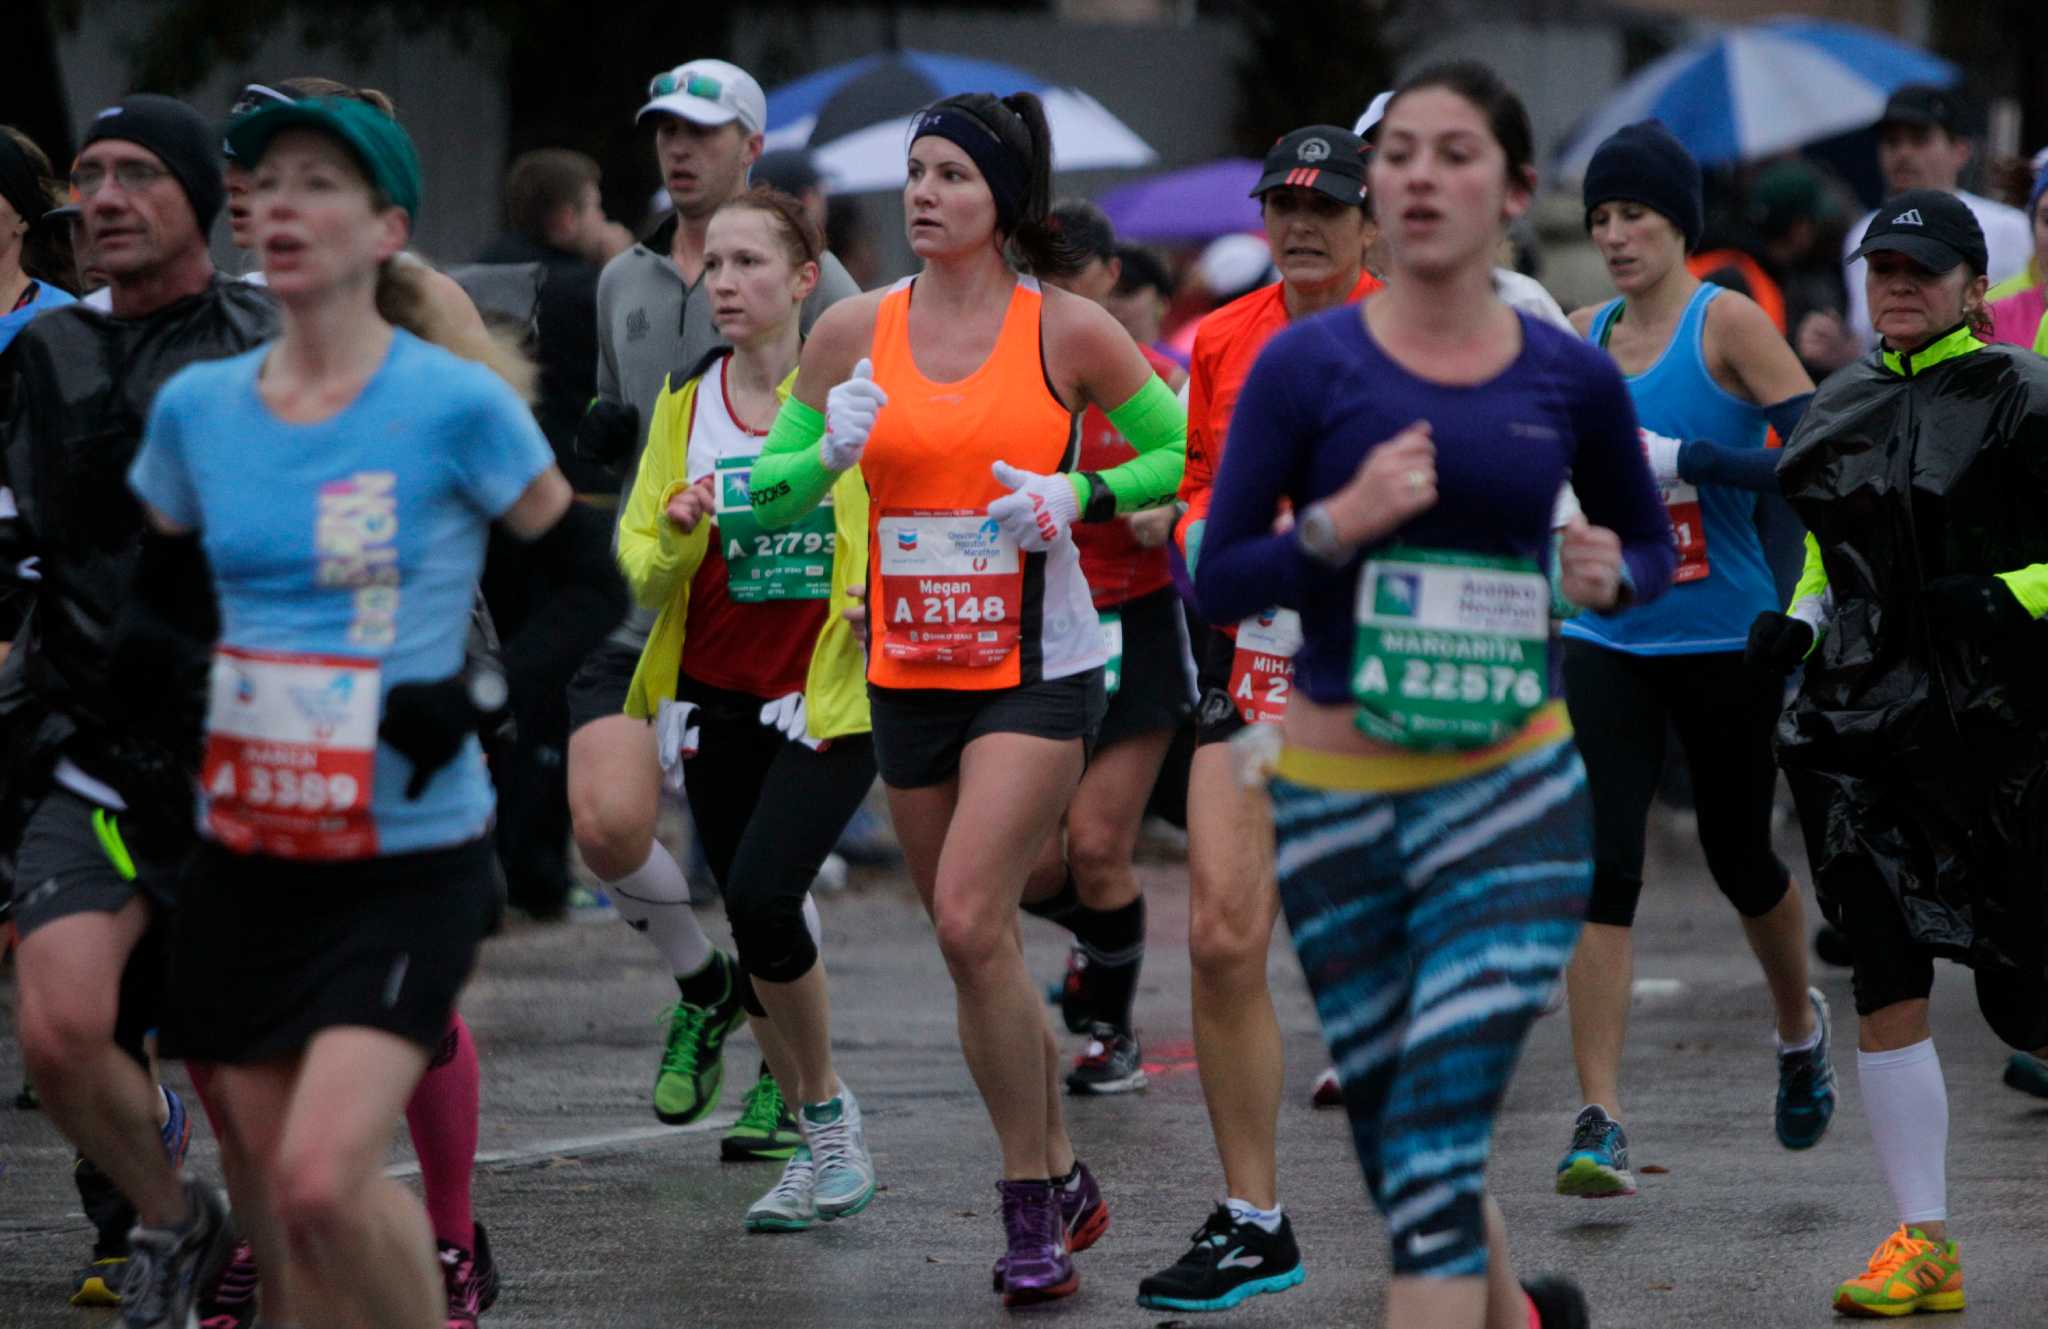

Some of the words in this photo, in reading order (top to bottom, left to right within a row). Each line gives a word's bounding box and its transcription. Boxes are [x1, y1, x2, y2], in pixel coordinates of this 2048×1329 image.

[728, 538, 747, 560] A
[754, 532, 836, 556] 27793
[919, 579, 971, 596] Megan
[894, 597, 913, 623] A
[923, 596, 1006, 624] 2148
[1381, 631, 1525, 663] MARGARITA
[1236, 672, 1254, 700] A
[1354, 655, 1389, 696] A
[1401, 658, 1542, 708] 22576
[210, 760, 236, 797] A
